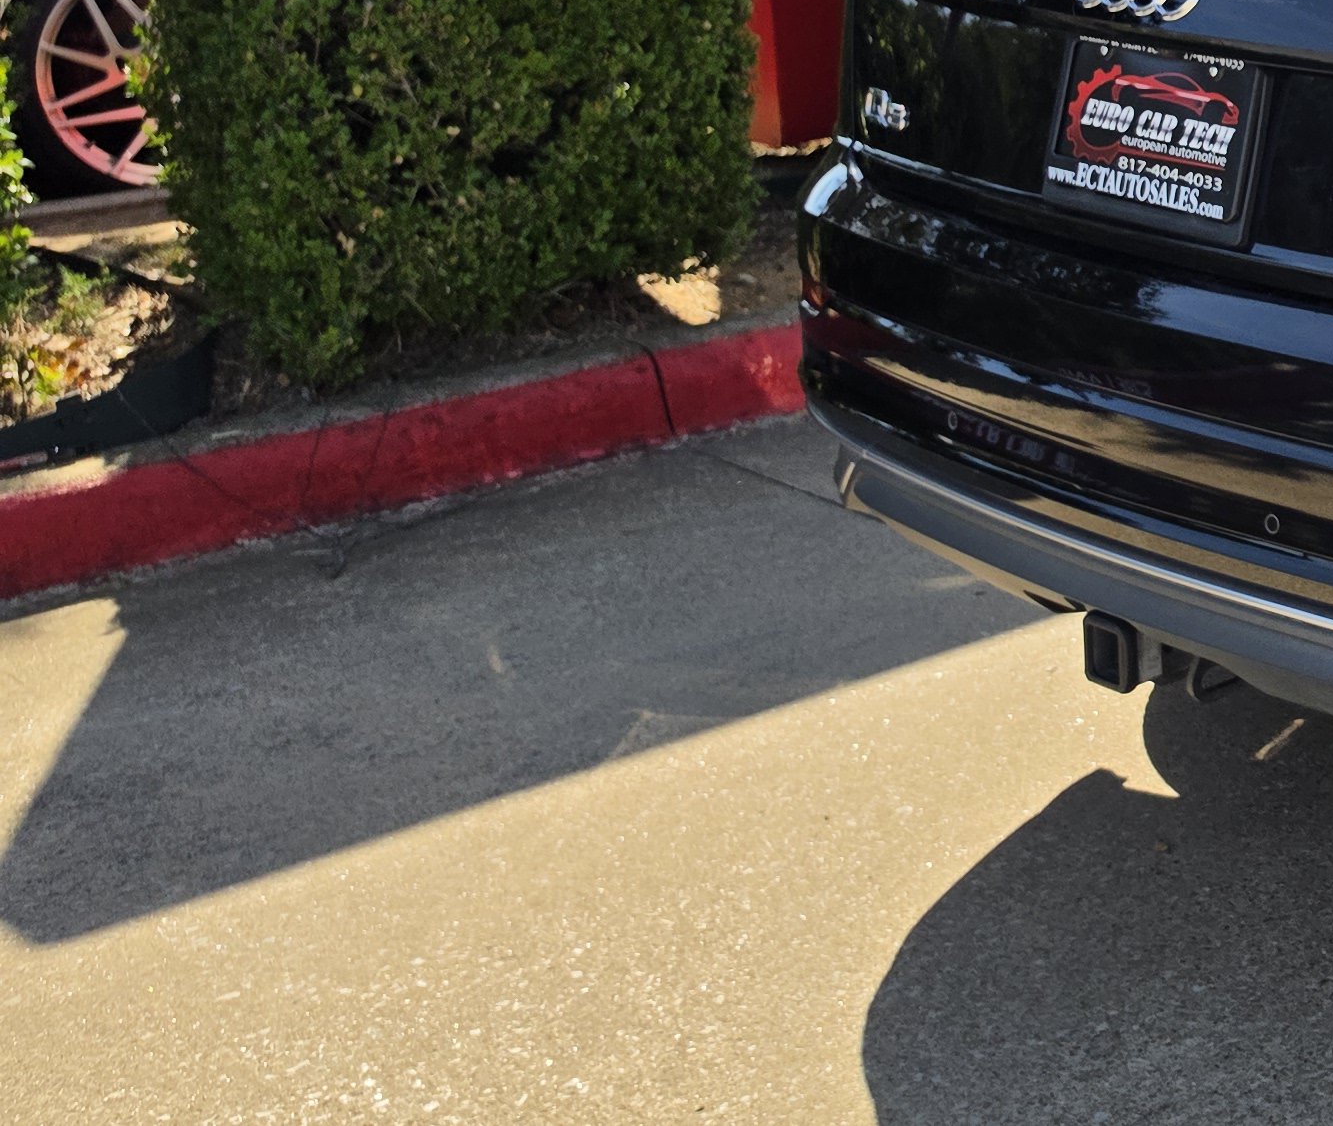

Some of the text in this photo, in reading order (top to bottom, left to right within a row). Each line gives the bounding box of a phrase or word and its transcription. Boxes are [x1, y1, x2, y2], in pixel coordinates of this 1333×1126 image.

[864, 86, 911, 131] Q8
[1080, 97, 1236, 155] EURO CAR TECH
[1121, 134, 1227, 167] european automotive
[1047, 162, 1224, 220] www.ECTAUTOSALES.com
[1118, 155, 1223, 192] 817-404-4033
